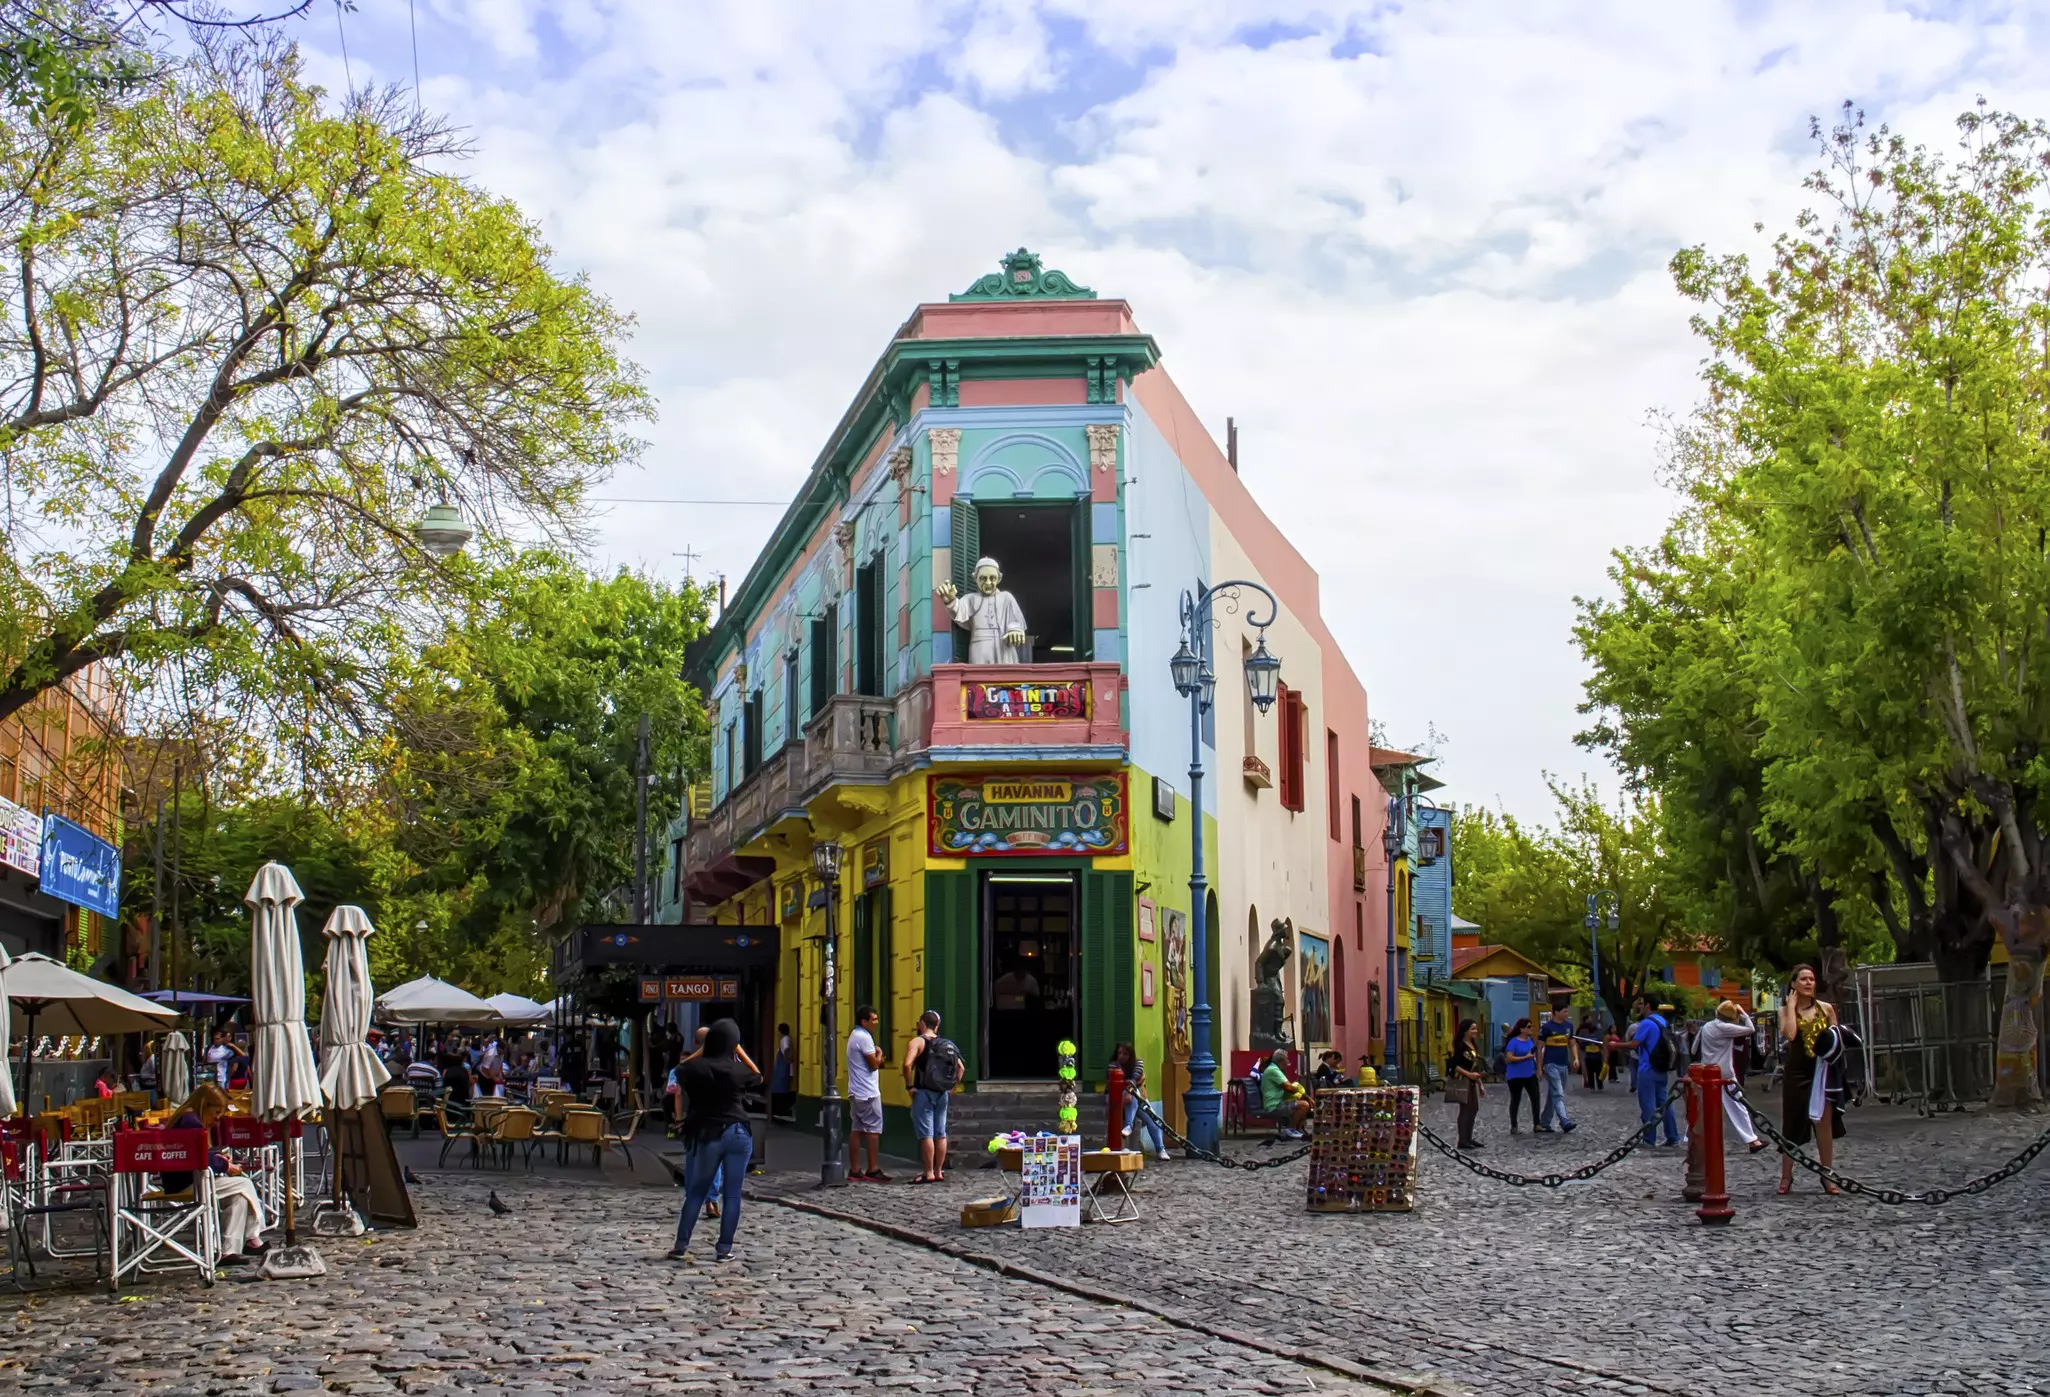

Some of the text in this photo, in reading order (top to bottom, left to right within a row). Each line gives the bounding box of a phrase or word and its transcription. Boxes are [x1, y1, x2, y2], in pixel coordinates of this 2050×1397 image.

[991, 785, 1065, 799] HAVANNA
[959, 801, 1098, 830] CAMINITO
[671, 984, 710, 994] TANGO
[134, 1151, 187, 1161] CAFE COFFEE
